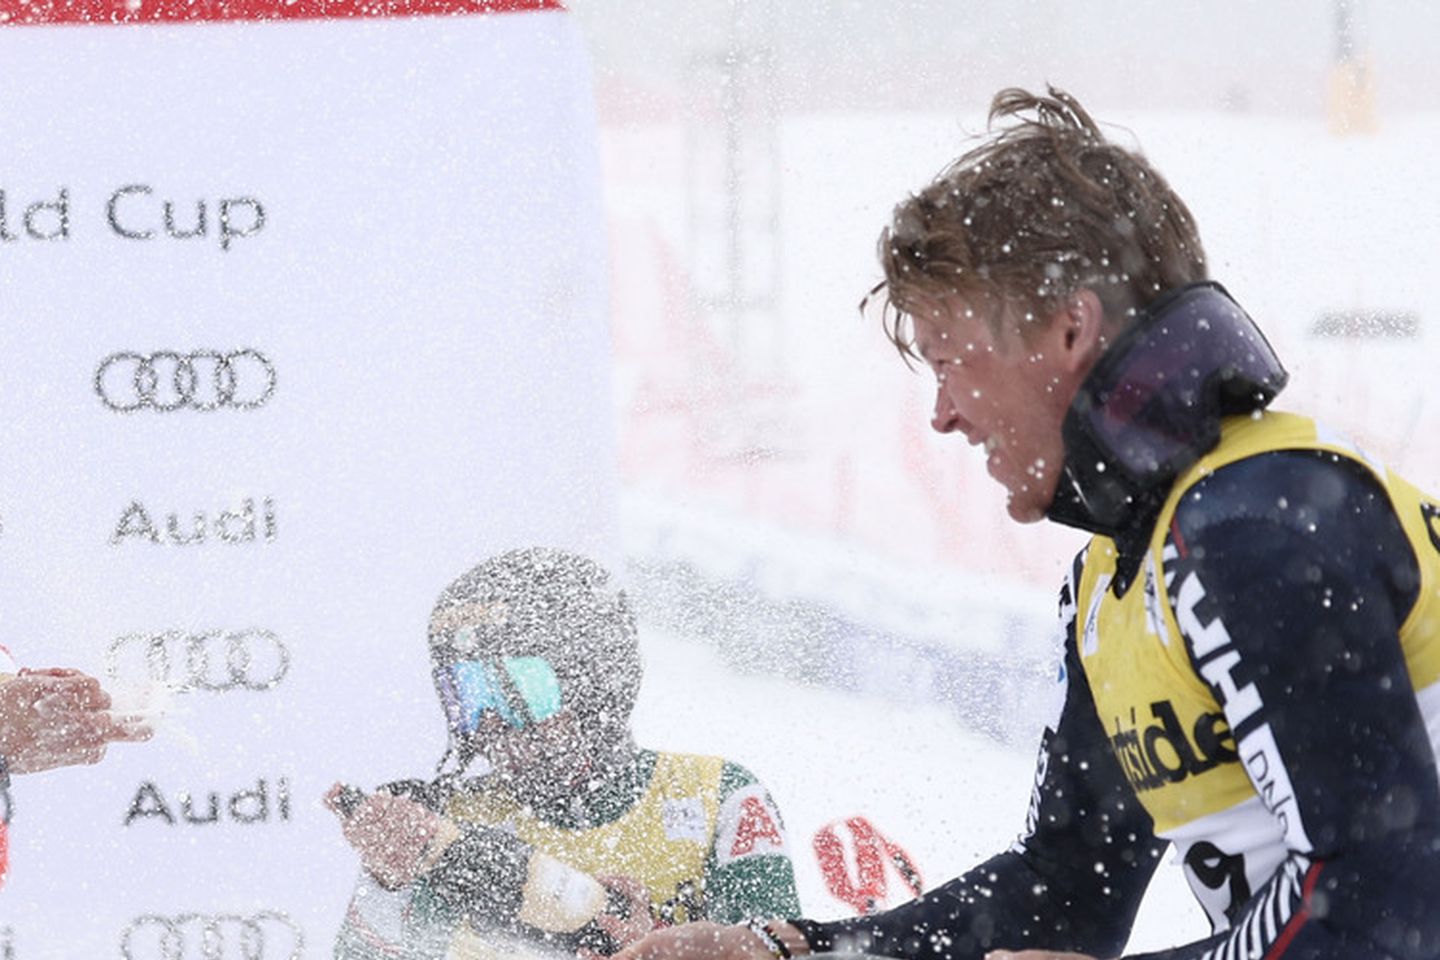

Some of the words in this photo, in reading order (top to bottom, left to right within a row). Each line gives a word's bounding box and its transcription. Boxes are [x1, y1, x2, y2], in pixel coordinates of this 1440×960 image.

[105, 184, 267, 250] Cup
[111, 497, 277, 545] Audi
[124, 777, 291, 827] Audi
